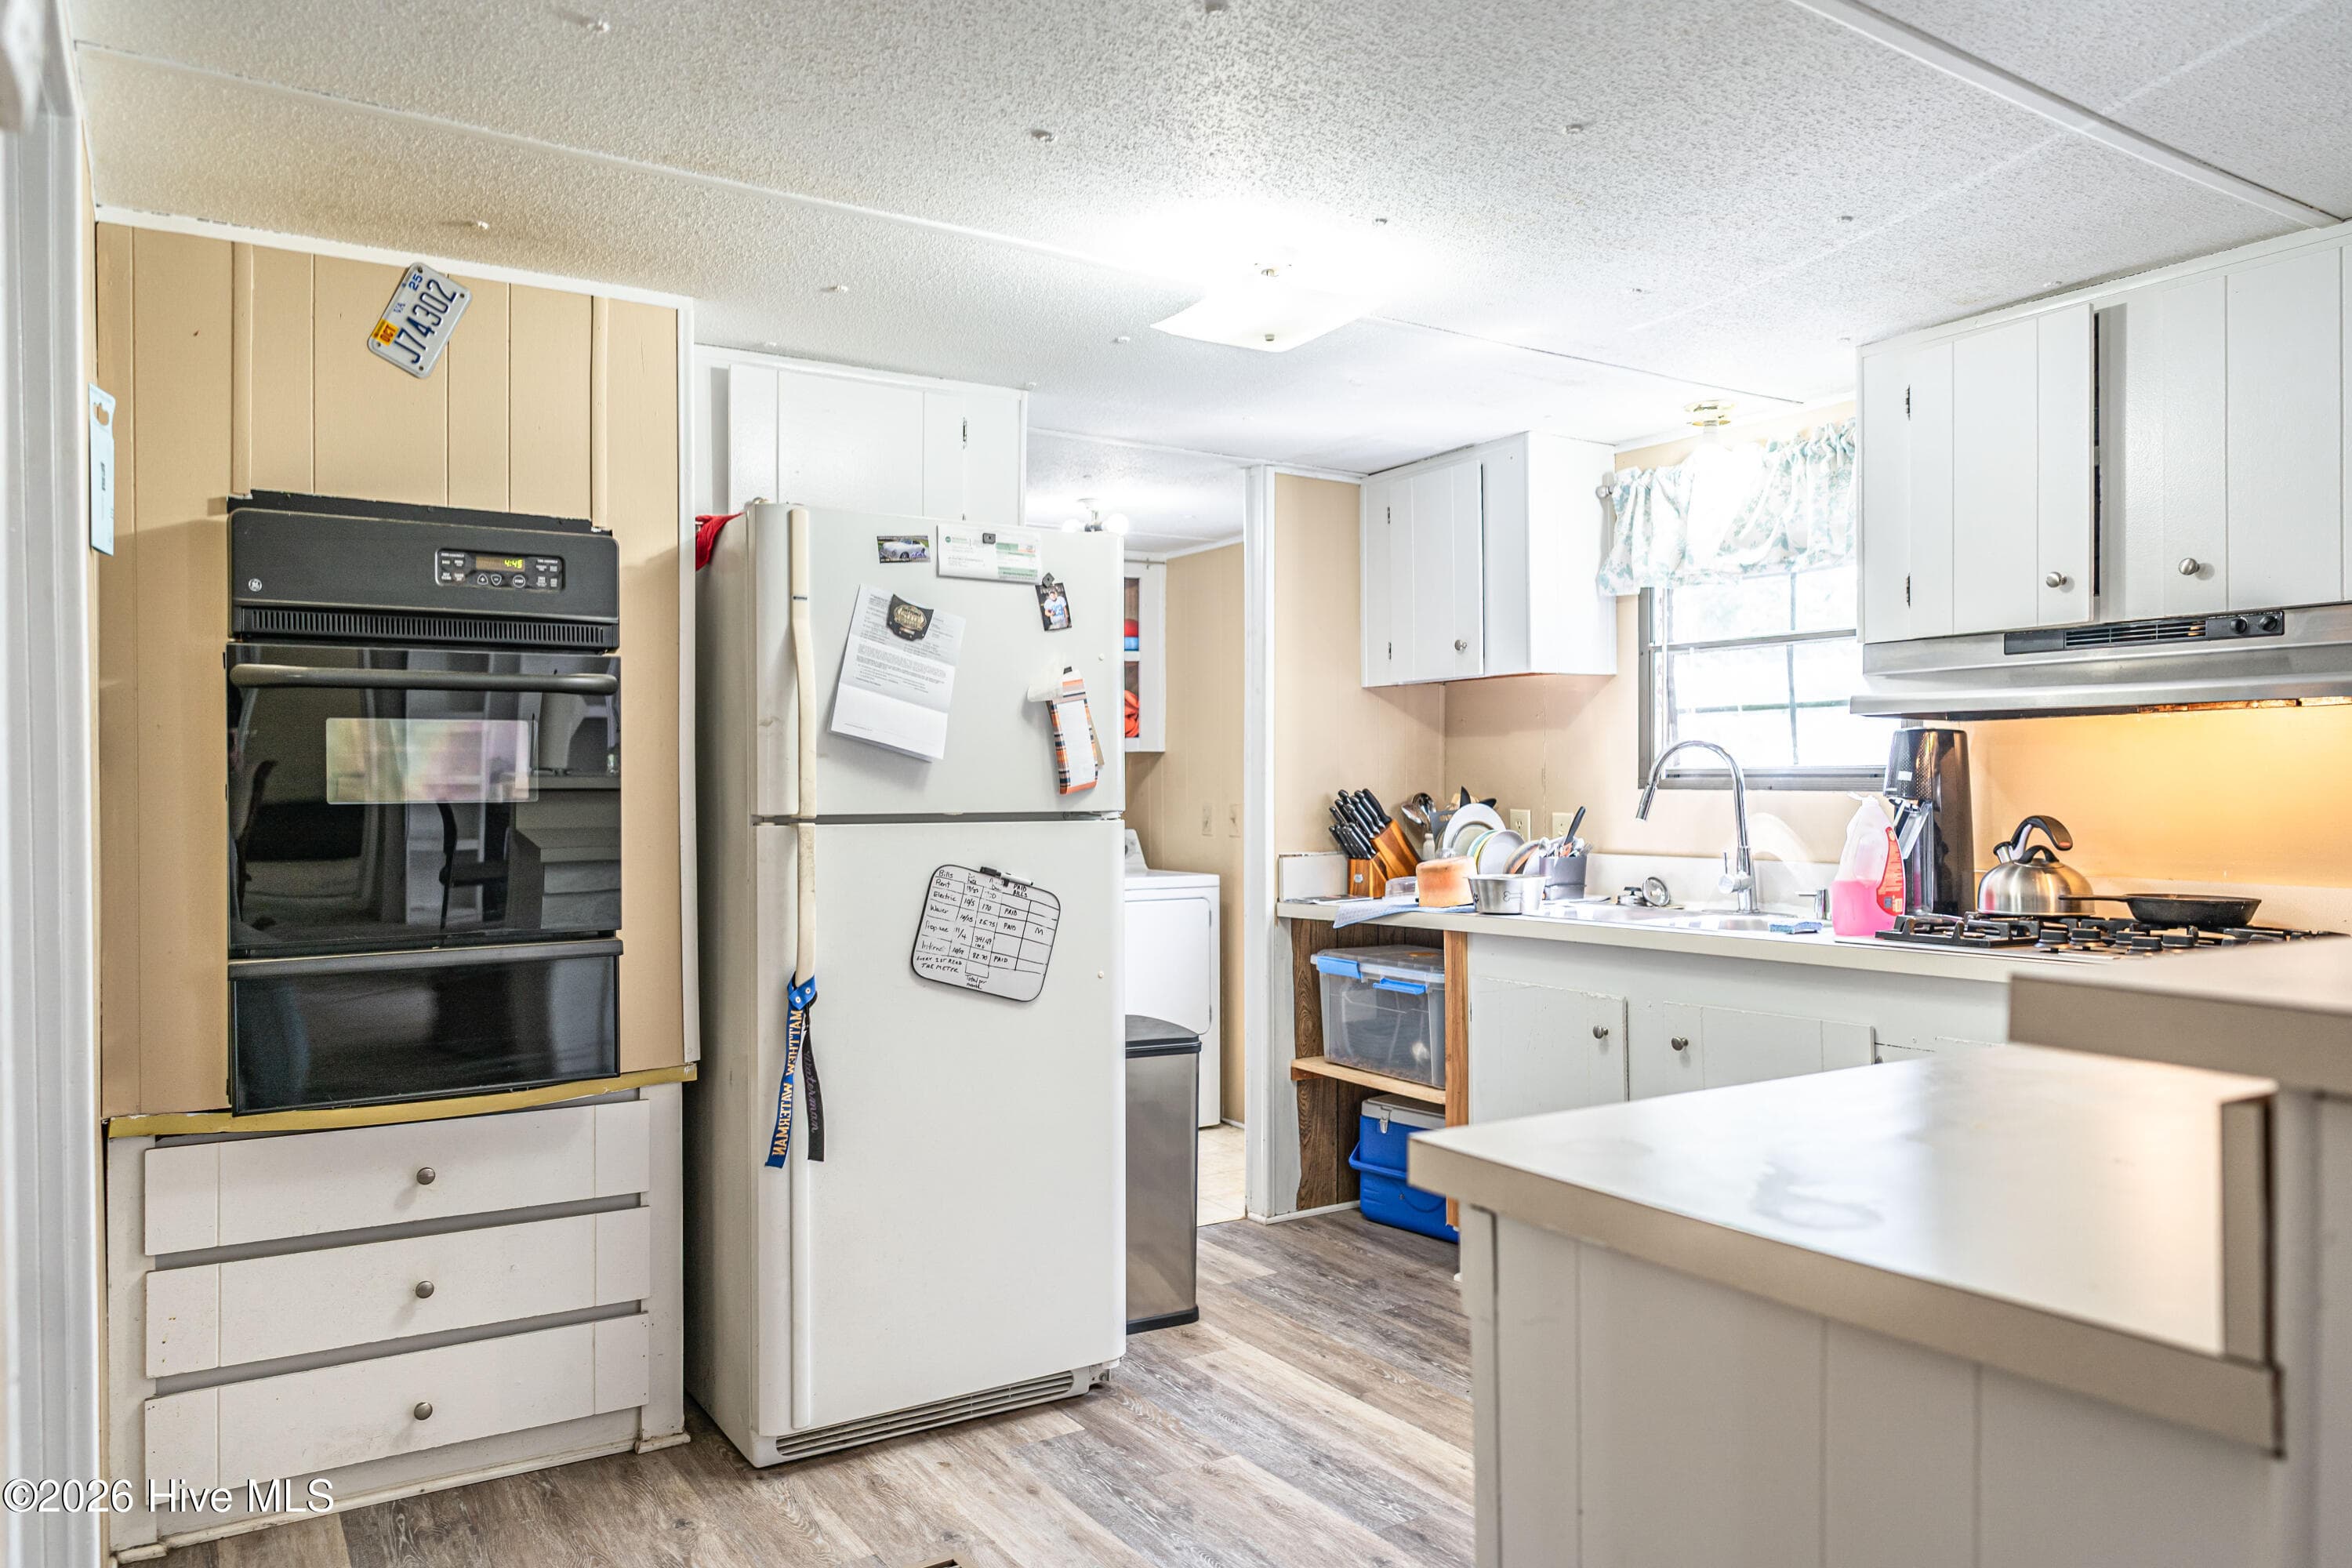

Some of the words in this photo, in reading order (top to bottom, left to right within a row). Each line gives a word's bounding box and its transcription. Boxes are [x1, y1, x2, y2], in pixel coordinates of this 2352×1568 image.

[379, 325, 396, 343] OCT
[394, 302, 406, 314] VA
[408, 273, 423, 292] 25
[394, 279, 457, 364] J74302
[938, 869, 954, 879] Bills
[935, 878, 951, 888] Rent
[1013, 884, 1027, 892] PAID
[933, 891, 957, 902] Electric
[1004, 923, 1016, 931] PAID
